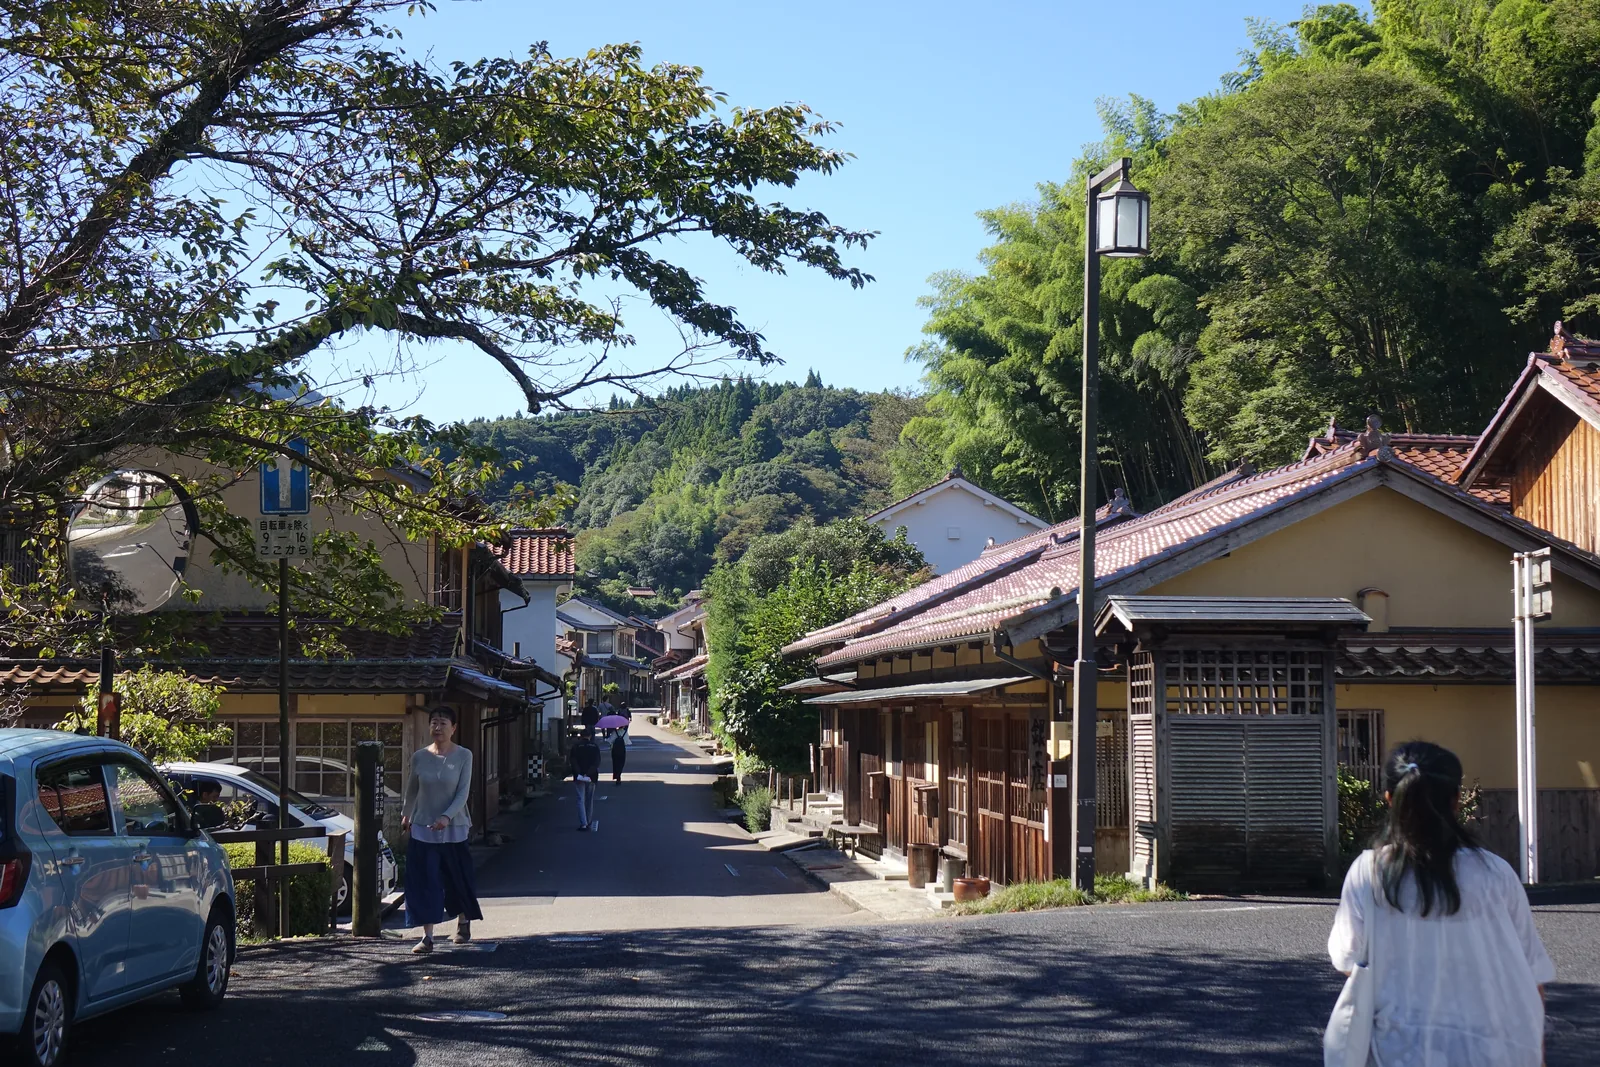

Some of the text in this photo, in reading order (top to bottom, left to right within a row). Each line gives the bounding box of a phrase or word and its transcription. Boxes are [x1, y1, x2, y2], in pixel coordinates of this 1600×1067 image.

[260, 520, 308, 531] 自転車を除く
[262, 532, 270, 543] 9
[295, 532, 306, 543] 16
[260, 545, 308, 555] ここから
